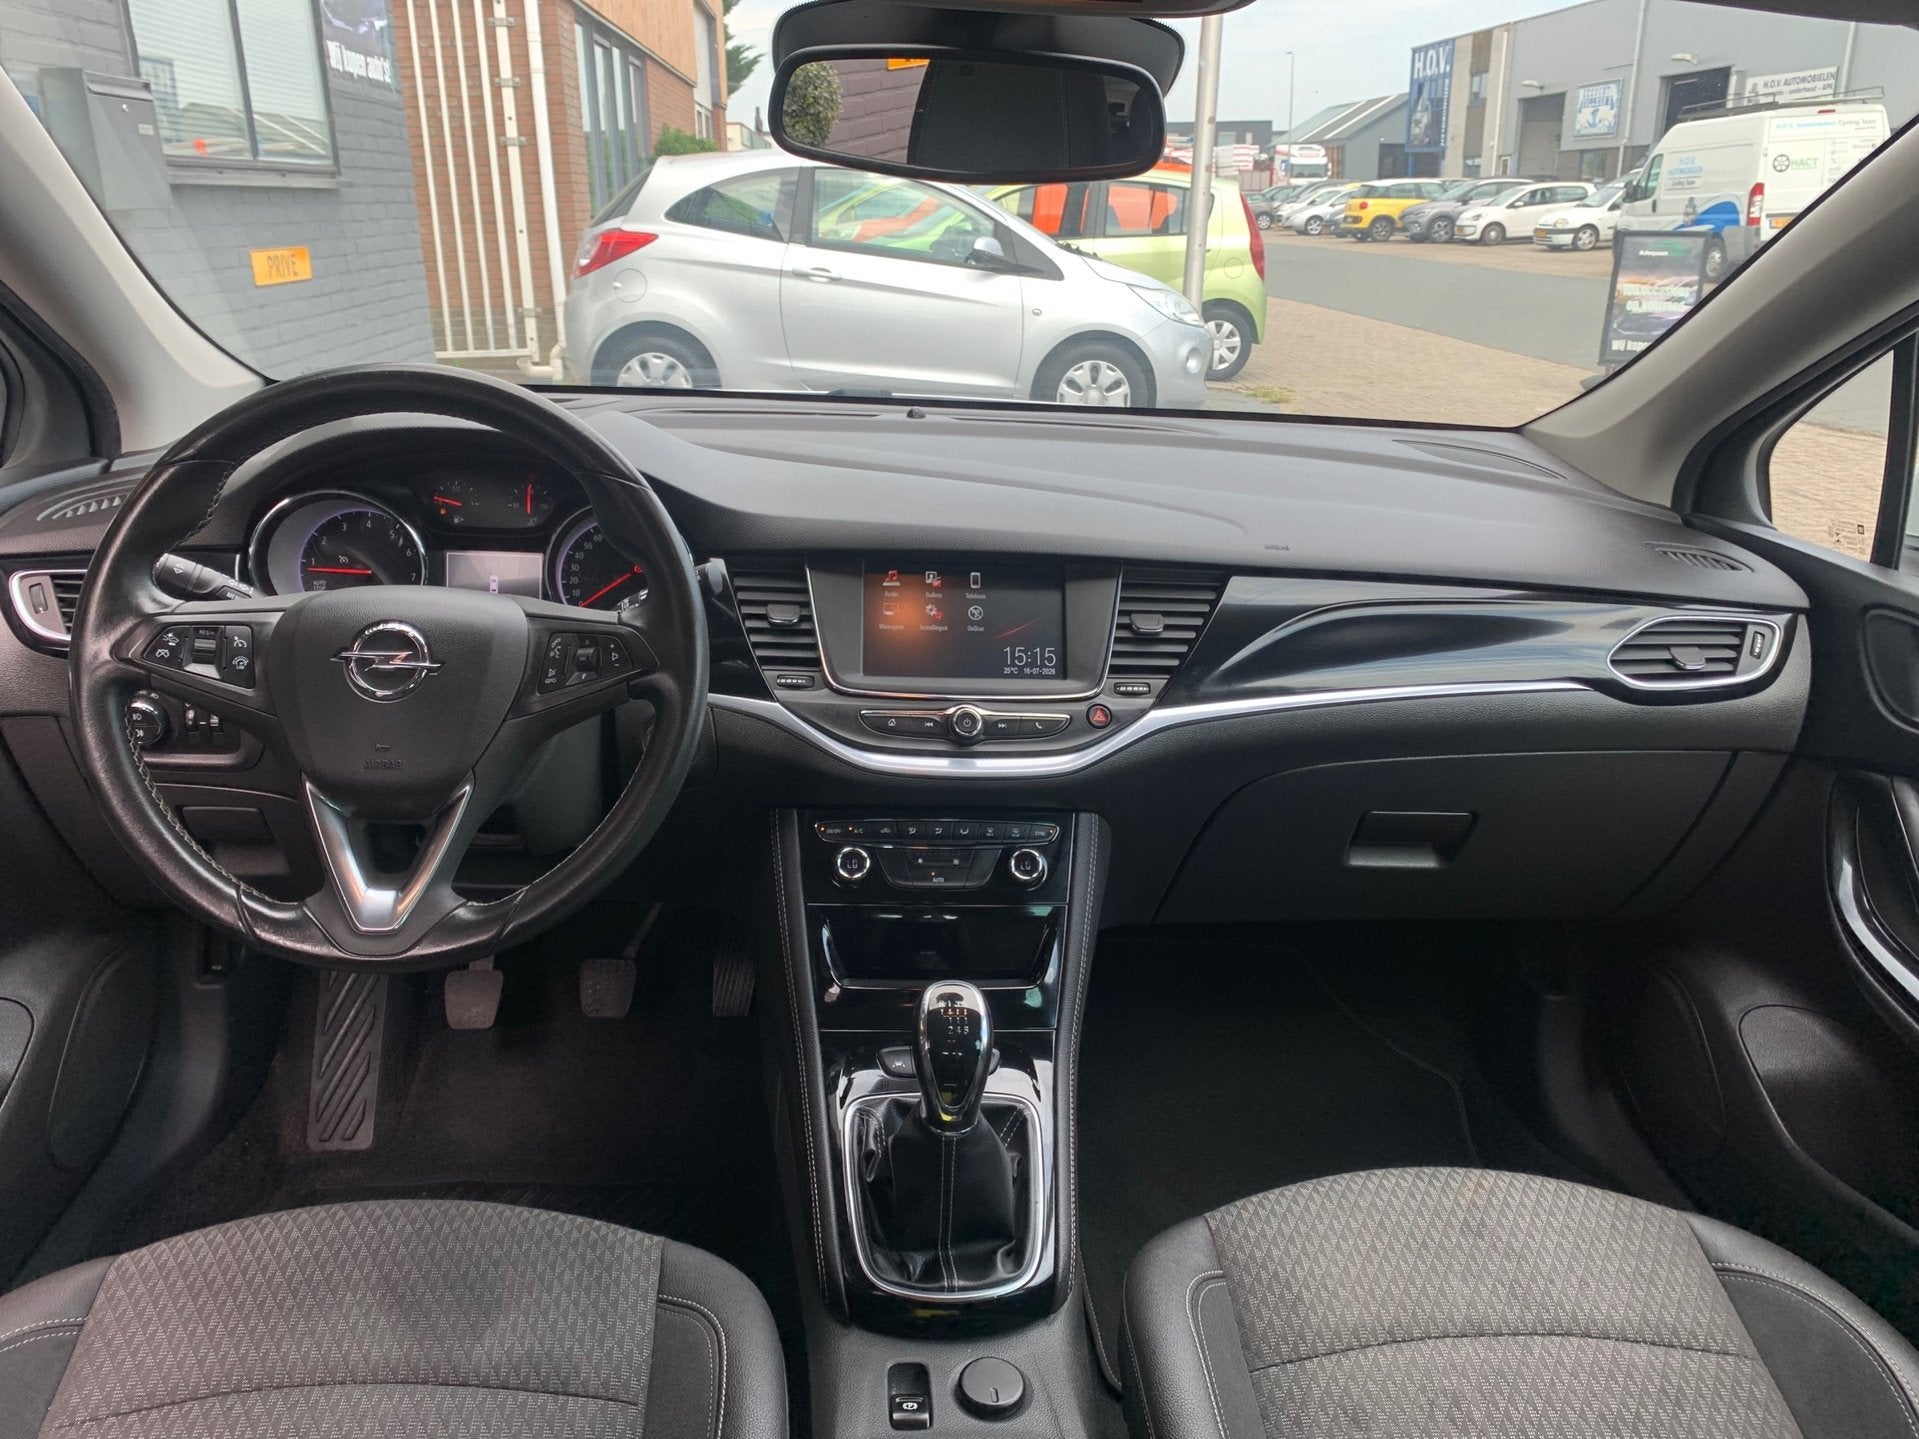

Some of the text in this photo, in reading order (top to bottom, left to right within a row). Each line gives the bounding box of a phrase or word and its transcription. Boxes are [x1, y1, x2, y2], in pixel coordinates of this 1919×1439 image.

[341, 45, 367, 78] kopen
[1414, 46, 1450, 79] H.O.V.
[1783, 72, 1836, 86] AUTOMOBIELEN
[1790, 158, 1819, 168] HACT
[341, 522, 347, 532] 3
[366, 519, 372, 529] 4
[389, 530, 395, 539] 5
[321, 536, 327, 545] 2
[583, 542, 593, 550] 50
[406, 548, 412, 557] 6
[574, 551, 584, 560] 40
[570, 563, 580, 572] 30
[411, 572, 416, 582] 7
[569, 576, 579, 584] 20
[572, 589, 581, 597] 10
[925, 591, 943, 600] Gallery
[1003, 646, 1056, 666] 15:15
